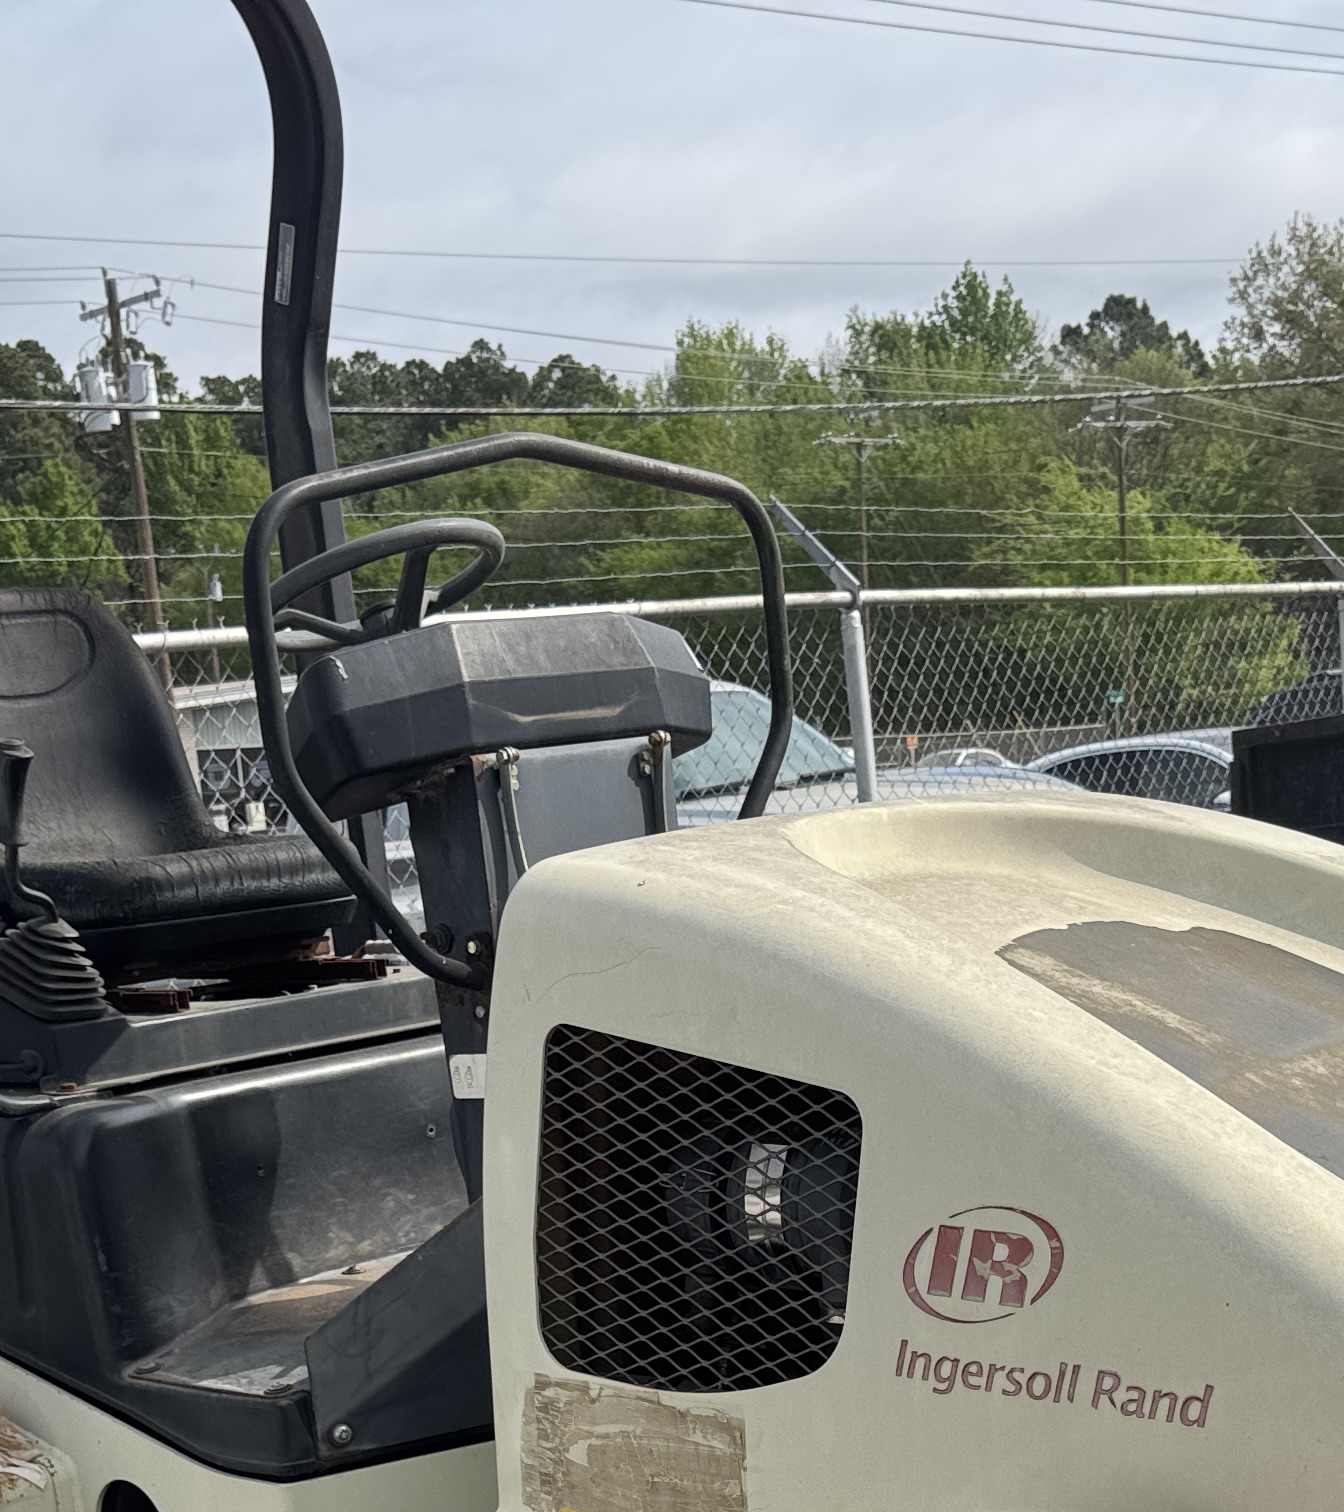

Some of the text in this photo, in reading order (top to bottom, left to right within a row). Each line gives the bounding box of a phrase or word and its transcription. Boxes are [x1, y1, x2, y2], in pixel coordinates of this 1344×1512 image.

[924, 1222, 1037, 1310] IR
[895, 1340, 1214, 1428] Ingersoll Rand
